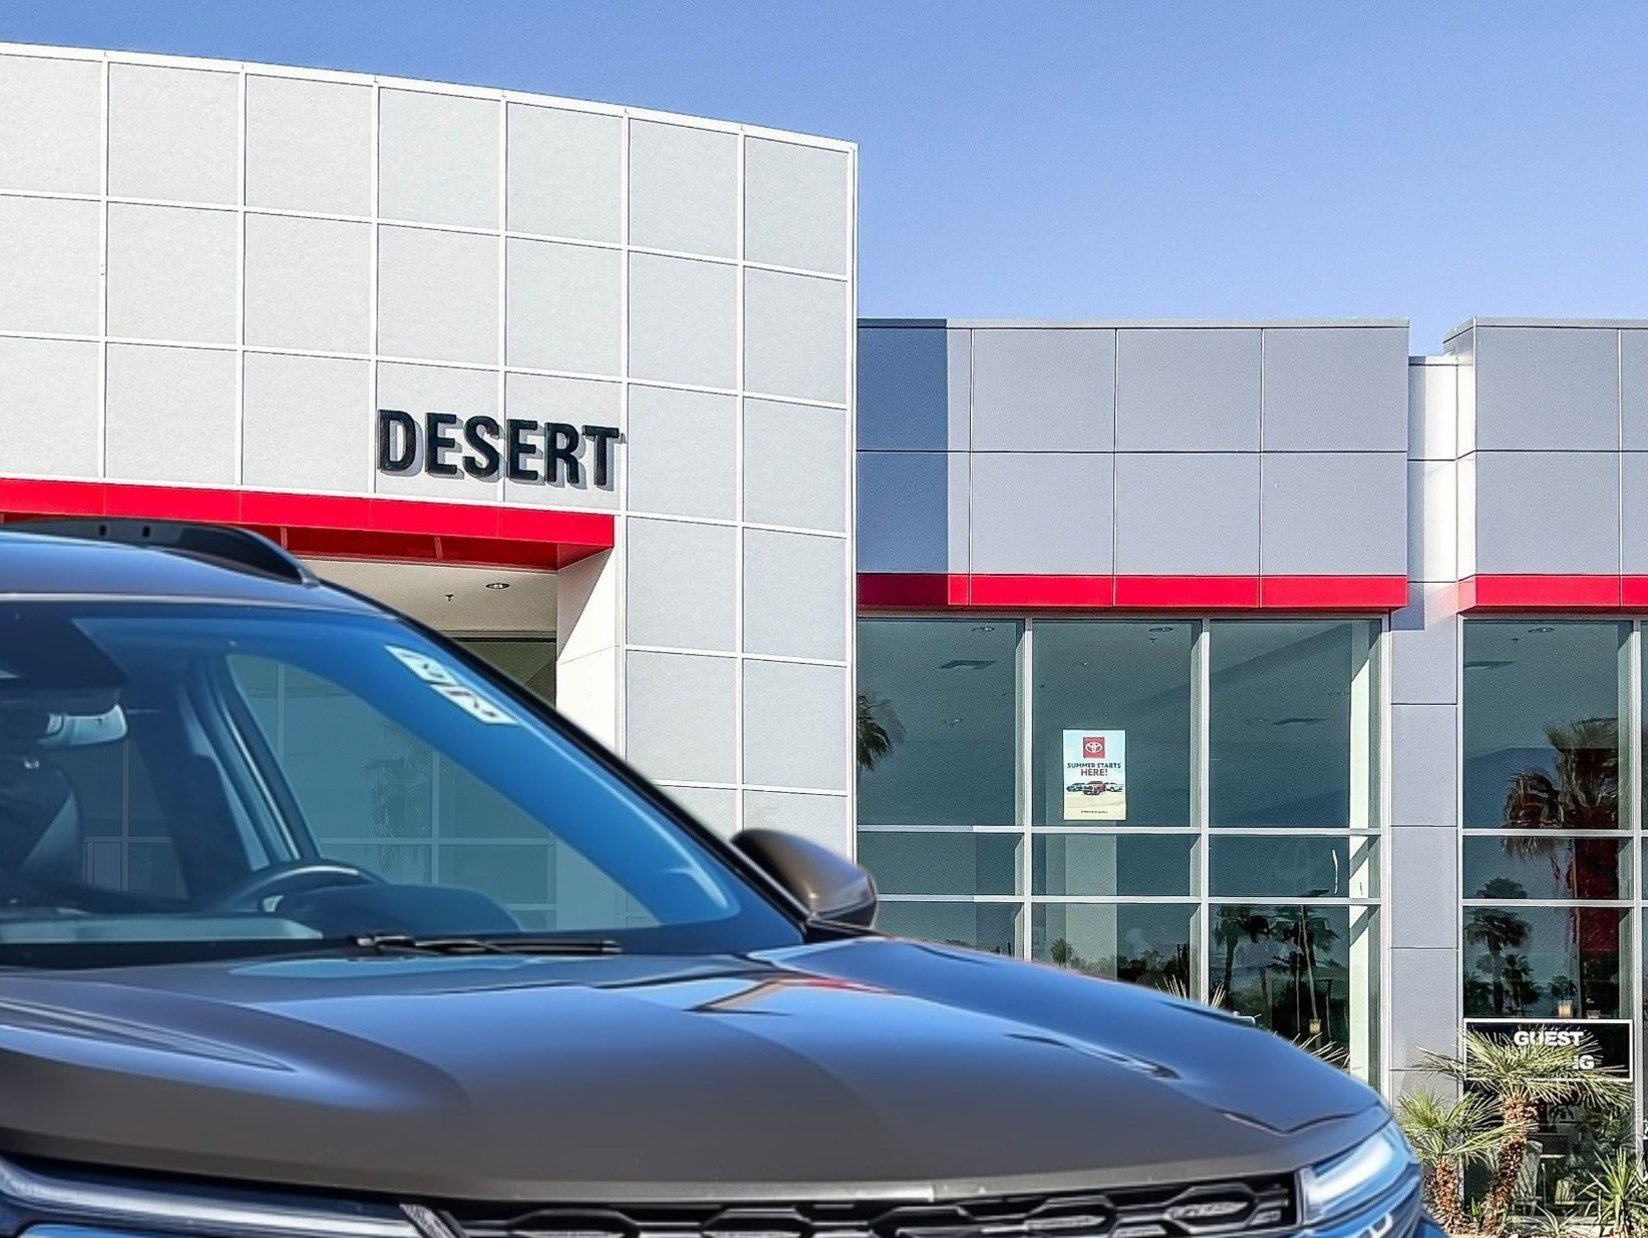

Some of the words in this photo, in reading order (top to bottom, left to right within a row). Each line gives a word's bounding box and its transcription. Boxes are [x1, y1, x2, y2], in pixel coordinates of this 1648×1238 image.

[377, 409, 620, 486] DESERT
[1080, 768, 1108, 776] HERE!
[1513, 1031, 1585, 1047] GUEST
